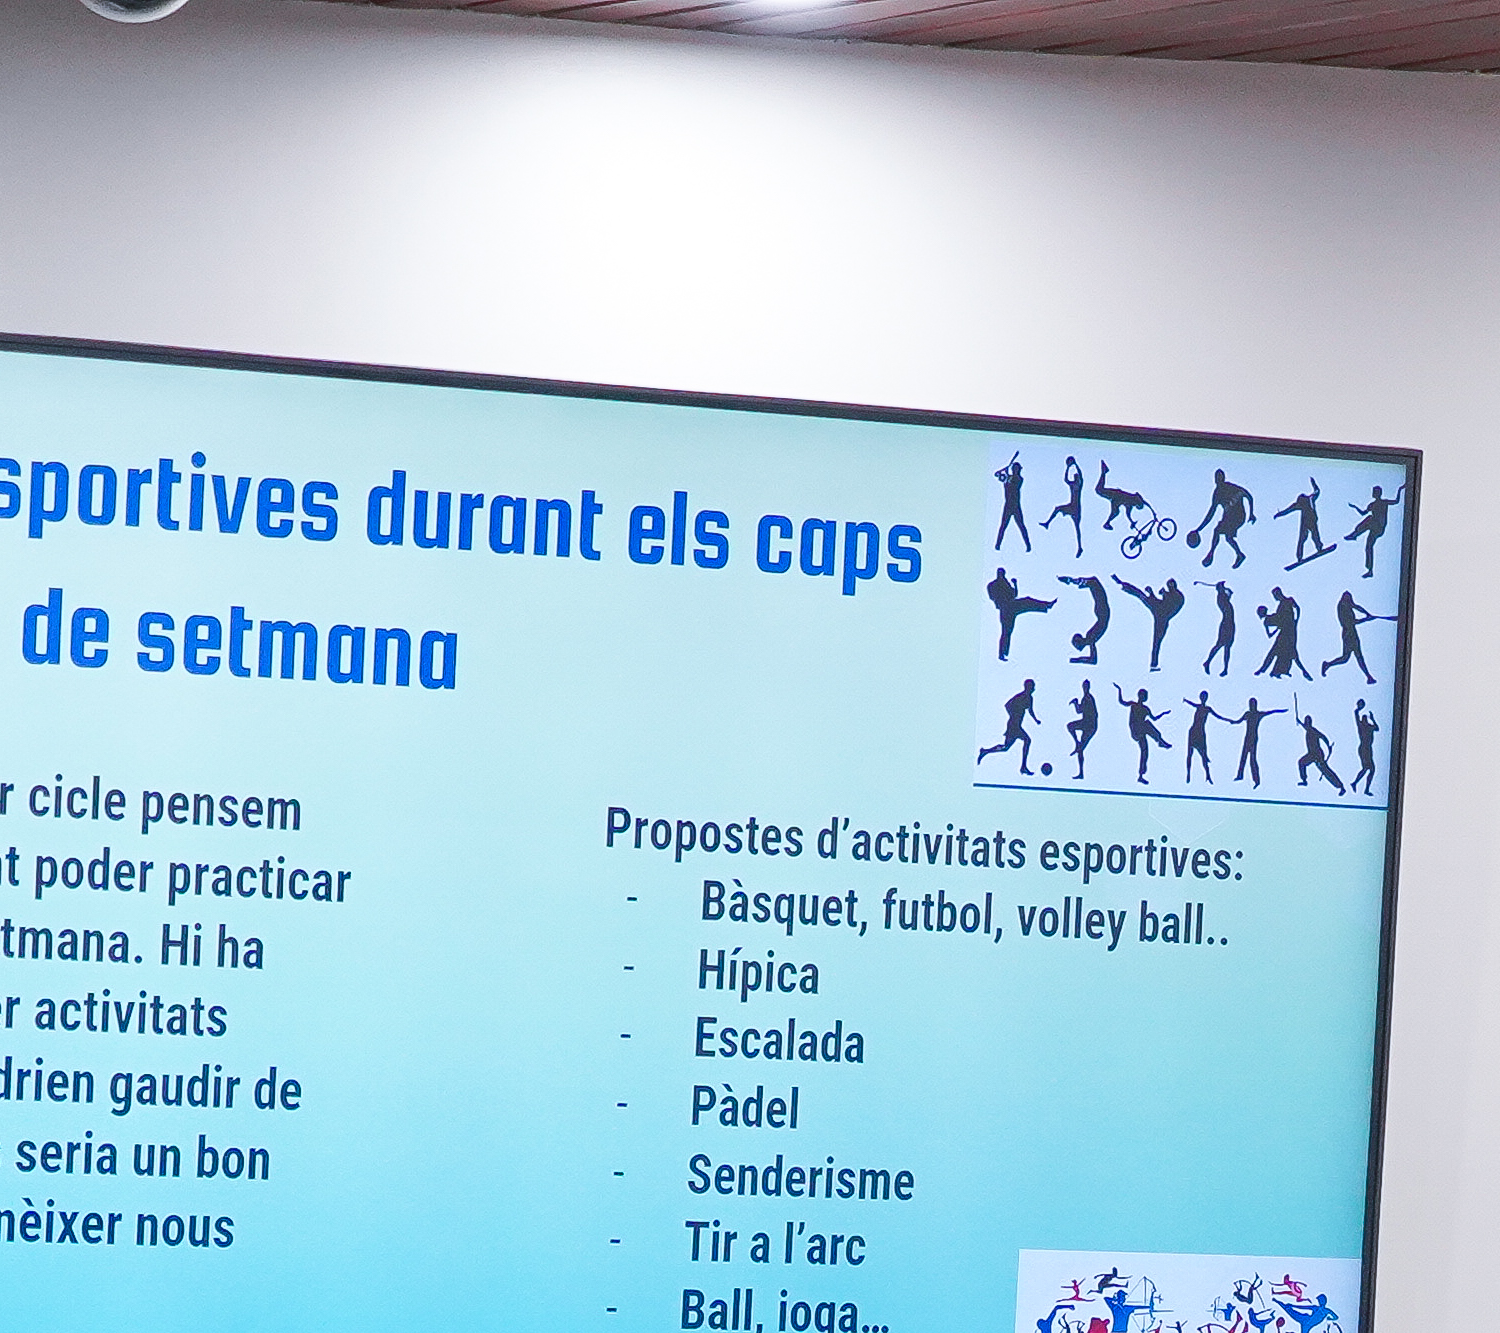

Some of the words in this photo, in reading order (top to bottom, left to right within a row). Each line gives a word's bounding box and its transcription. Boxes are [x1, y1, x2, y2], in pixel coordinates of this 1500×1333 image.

[366, 469, 604, 562] durant
[627, 490, 730, 570] els
[755, 514, 923, 597] caps
[21, 586, 110, 669] de
[136, 605, 458, 690] setmana
[28, 773, 127, 822] cicle
[141, 790, 301, 836] pensem
[605, 806, 804, 864] Propostes
[817, 816, 1027, 870] d'activitats
[1039, 834, 1244, 885] esportives:
[34, 846, 155, 901] poder
[167, 855, 352, 907] practicar
[701, 878, 868, 938] Bàsquet,
[882, 887, 1003, 945] futbol,
[1016, 895, 1128, 952] volley
[160, 922, 203, 967] Hi
[216, 923, 264, 970] ha
[698, 946, 819, 1004] Hípica
[34, 988, 228, 1038] activitats
[695, 1015, 865, 1064] Escalada
[109, 1063, 241, 1117] gaudir
[253, 1065, 302, 1111] de
[691, 1082, 799, 1130] Pàdel
[15, 1130, 118, 1176] seria
[133, 1143, 181, 1178] un
[196, 1133, 270, 1181] bon
[687, 1153, 915, 1201] Senderisme
[135, 1213, 235, 1249] nous
[684, 1219, 738, 1263] Tir
[749, 1232, 770, 1264] a
[784, 1221, 866, 1266] l'arc
